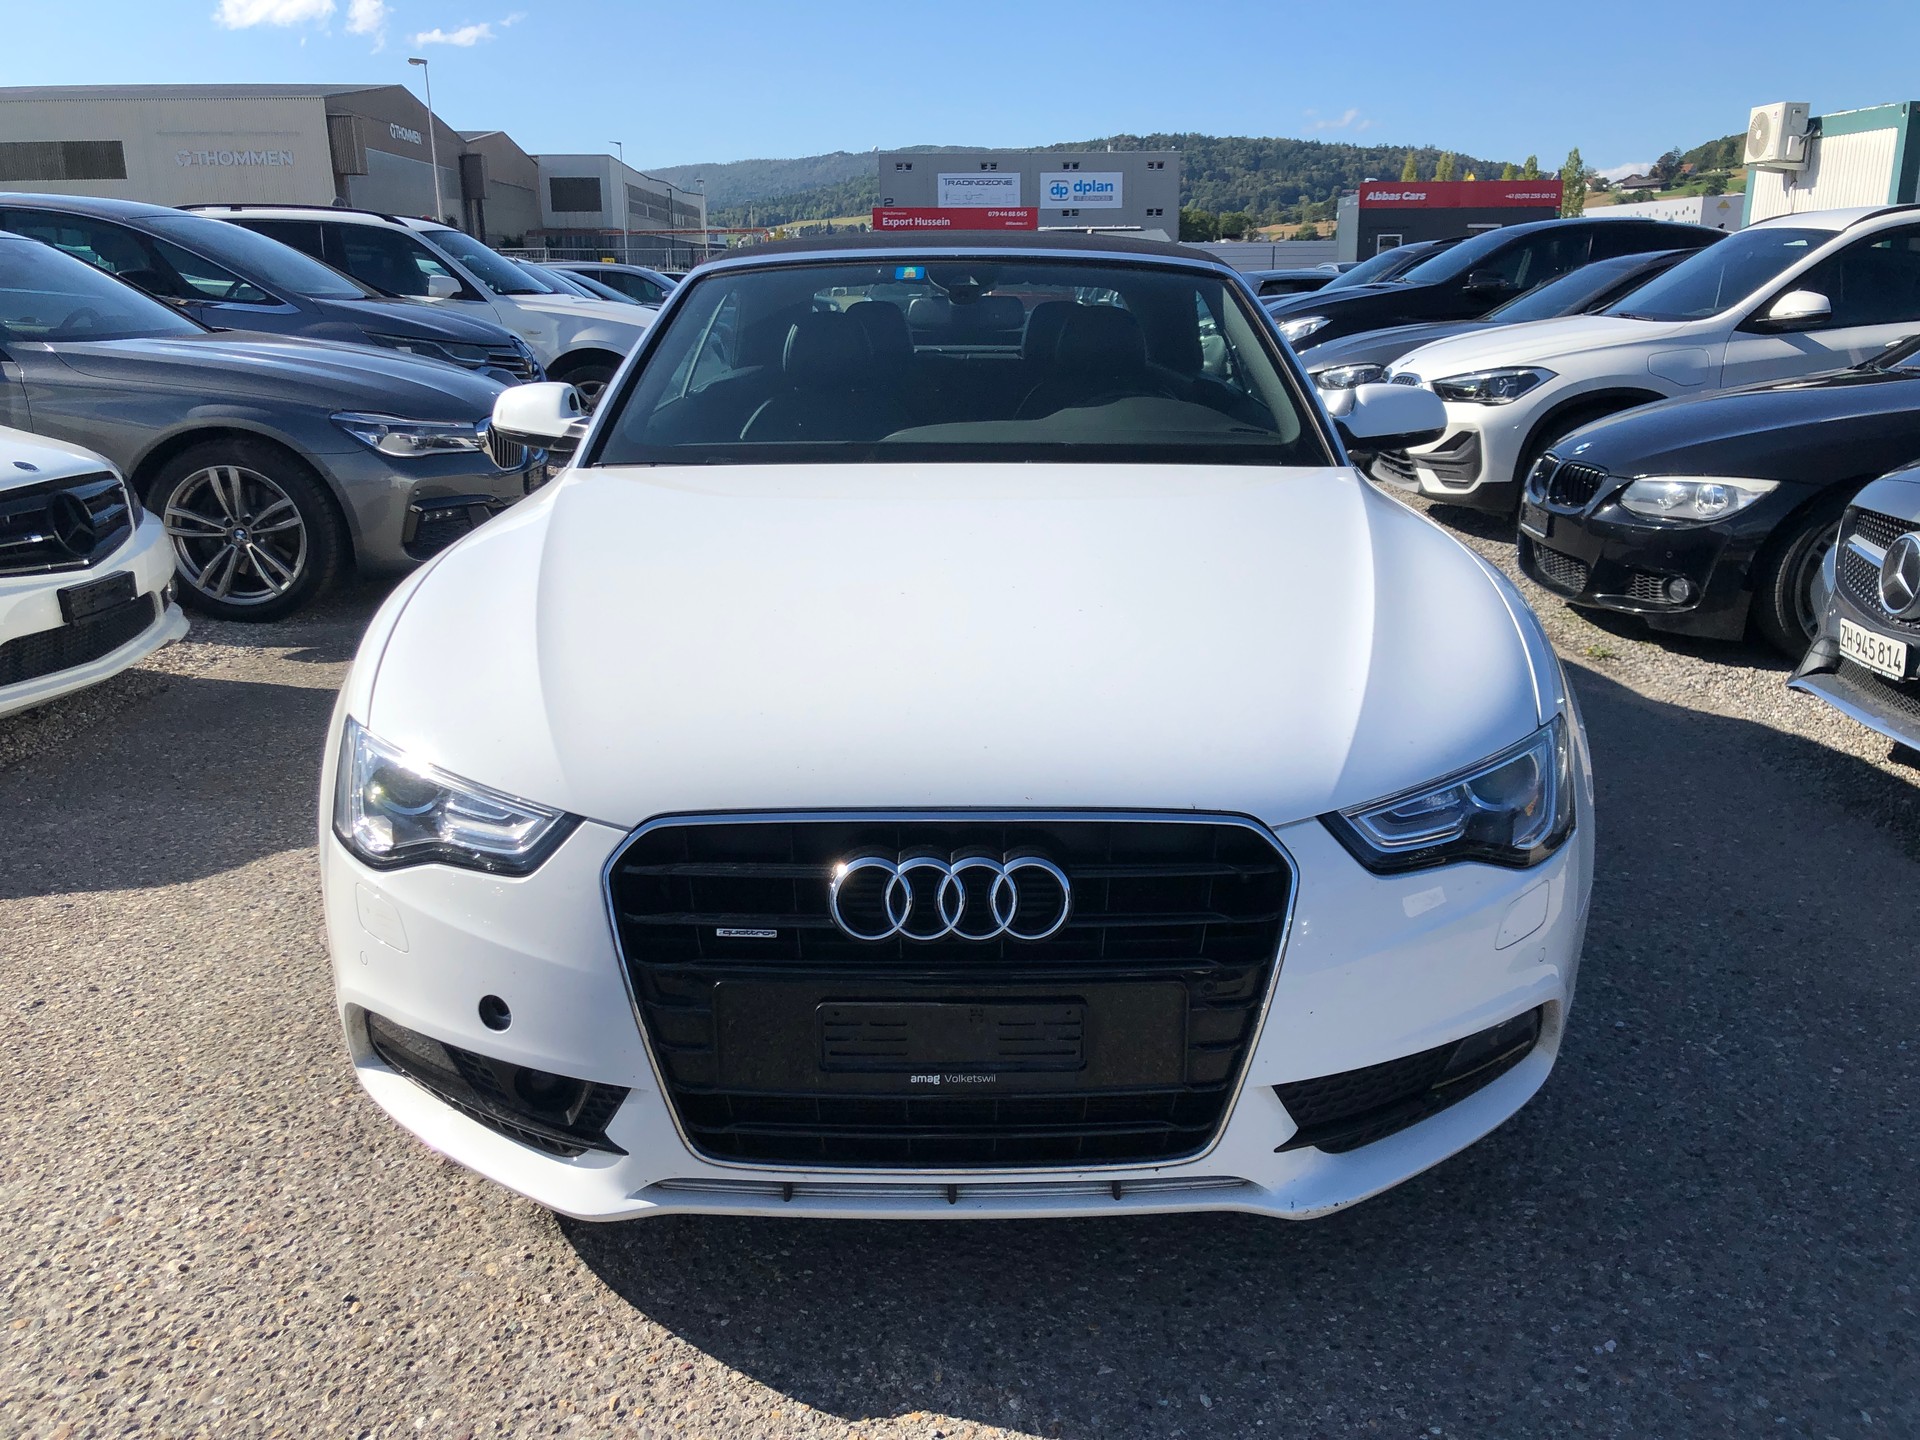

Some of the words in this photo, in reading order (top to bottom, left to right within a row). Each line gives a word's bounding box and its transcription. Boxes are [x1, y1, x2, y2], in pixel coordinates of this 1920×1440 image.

[394, 124, 422, 146] THOMMEN
[198, 150, 294, 167] THOMMEN
[1073, 179, 1114, 195] dplan
[1365, 191, 1401, 201] Abbas
[1402, 191, 1427, 201] Cars
[882, 217, 914, 228] Export
[915, 217, 951, 226] Hussein
[910, 1074, 941, 1085] amag
[944, 1073, 996, 1083] Volketswil
